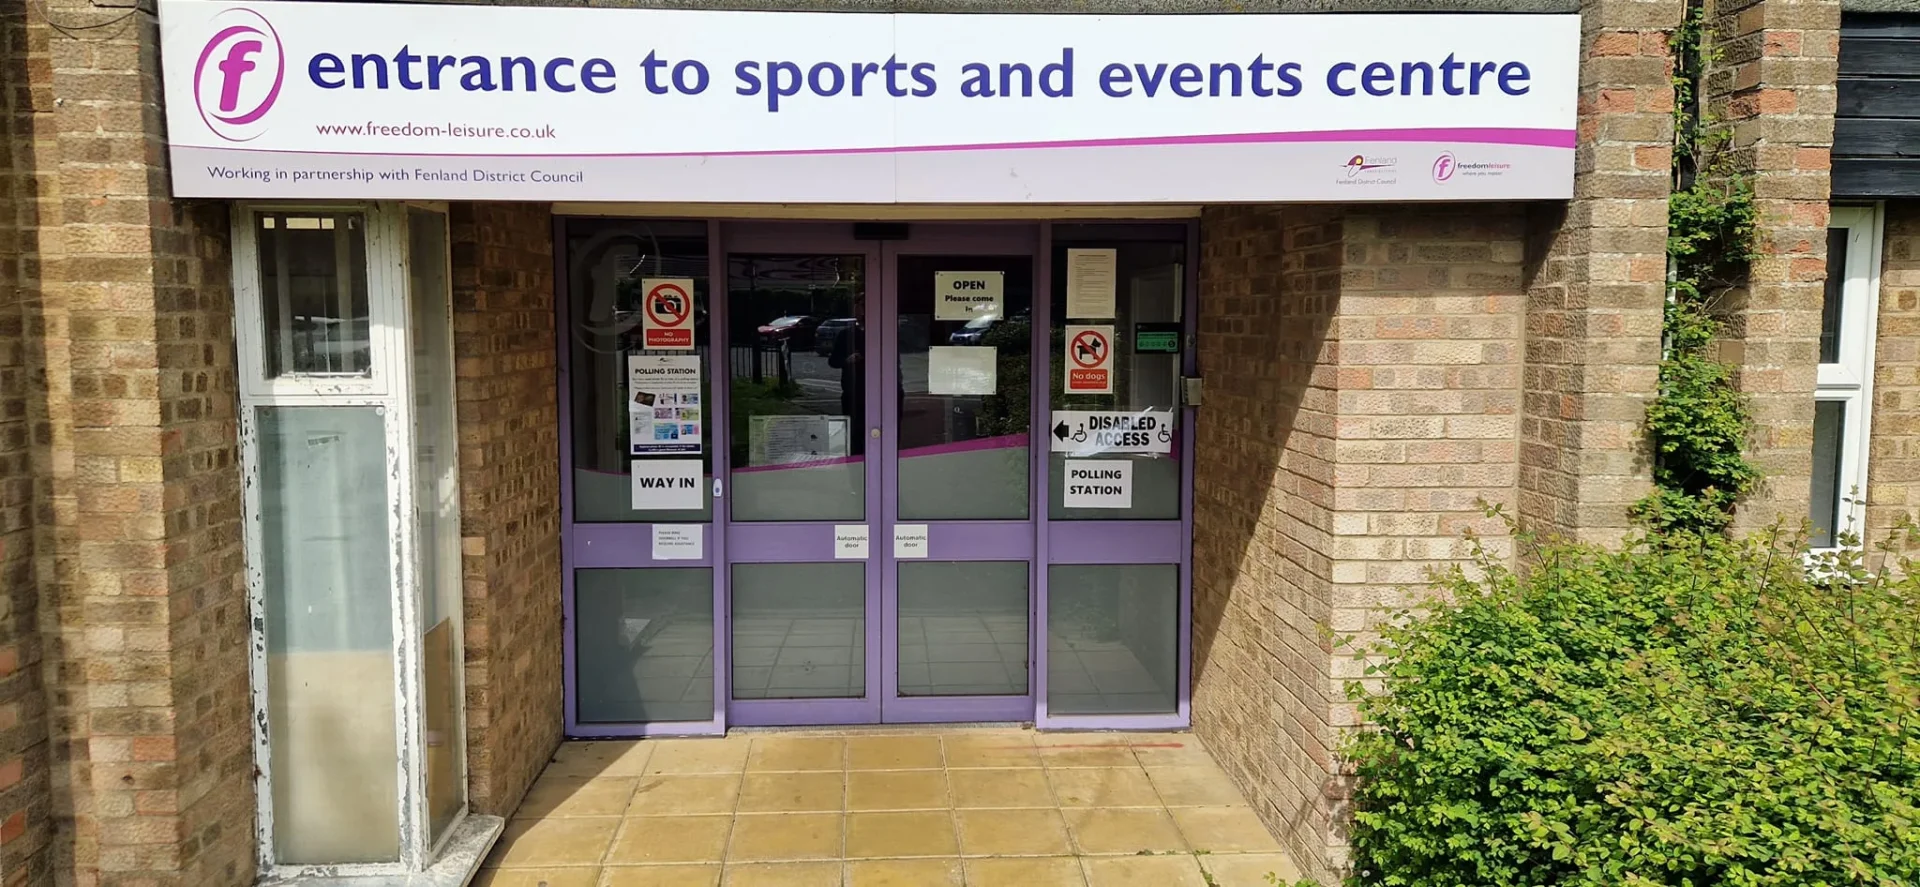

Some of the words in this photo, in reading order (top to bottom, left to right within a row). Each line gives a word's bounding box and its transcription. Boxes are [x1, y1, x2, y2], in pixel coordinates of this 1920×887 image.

[307, 44, 617, 94] entrance
[640, 50, 710, 95] to
[734, 53, 937, 112] sports
[960, 47, 1074, 98] and
[1098, 53, 1303, 98] events
[1326, 52, 1531, 97] centre
[316, 120, 556, 140] www.freedom-leisure.co.uk
[1365, 155, 1397, 164] Fenland
[1457, 162, 1511, 170] freedomleisure
[207, 166, 271, 183] Working
[275, 168, 288, 181] in
[292, 168, 374, 184] partnership
[379, 168, 410, 182] with
[414, 168, 468, 182] Fenland
[473, 168, 526, 183] District
[530, 170, 583, 184] Council
[953, 280, 986, 290] OPEN
[945, 294, 971, 302] Please
[1072, 372, 1084, 380] No
[1085, 371, 1106, 382] dogs
[1088, 415, 1157, 431] DISABLED
[1094, 432, 1150, 447] ACCESS
[1071, 469, 1122, 480] POLLING
[640, 477, 675, 488] WAY
[679, 477, 695, 488] IN
[1070, 485, 1122, 495] STATION
